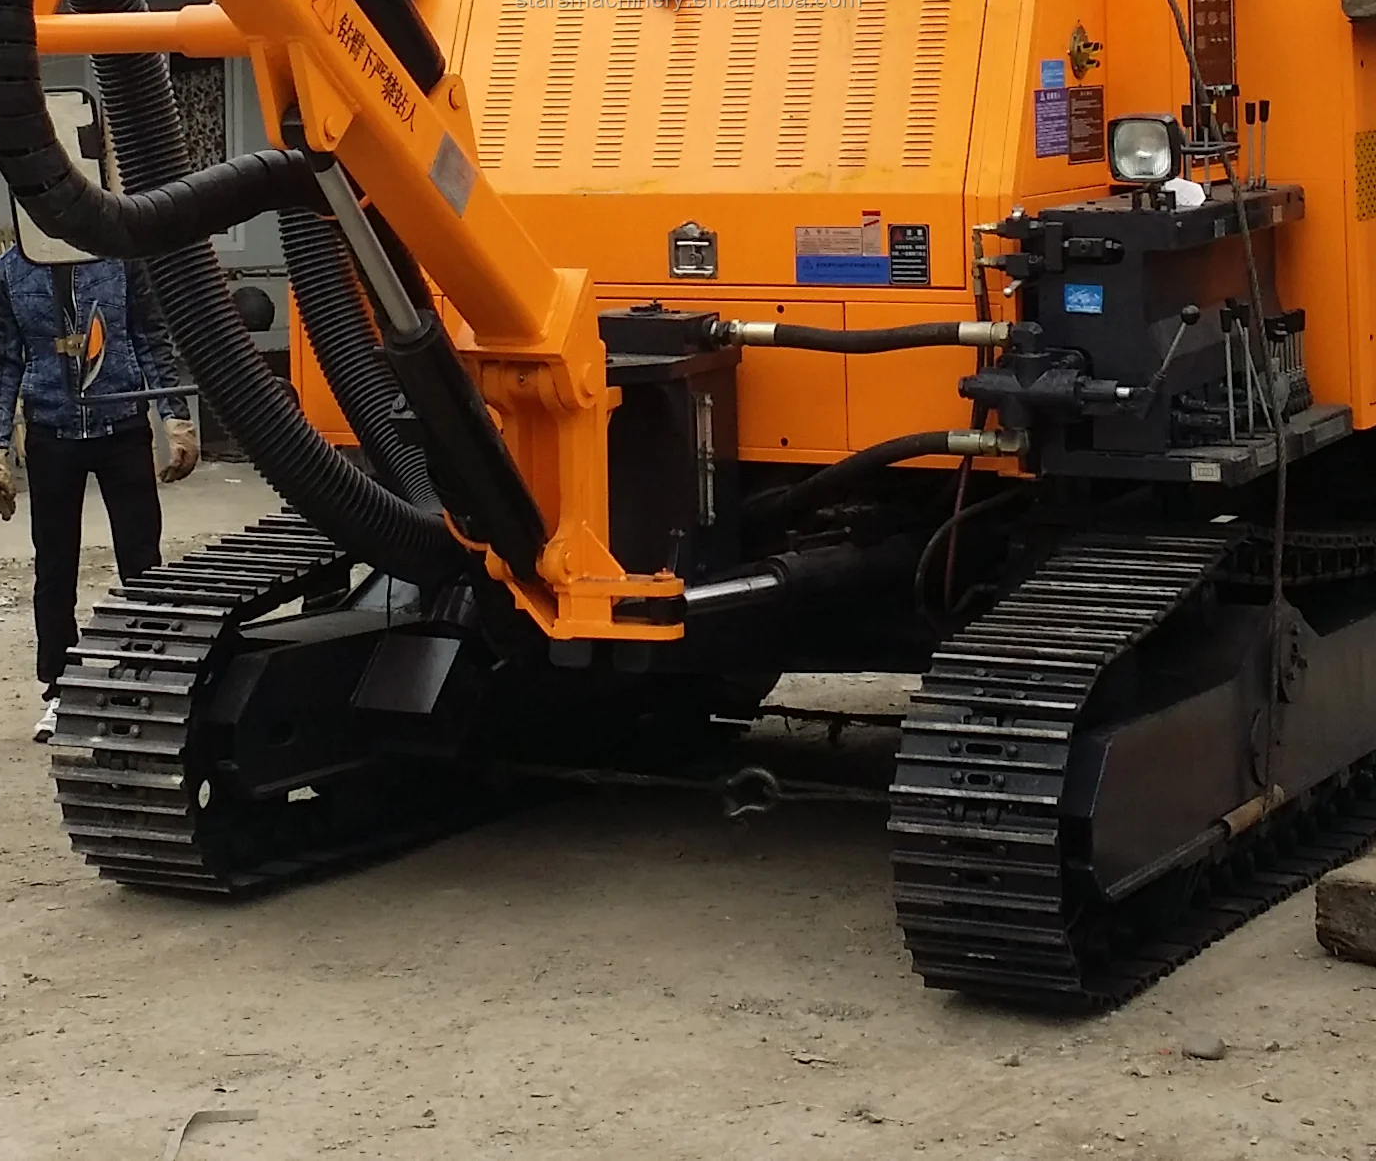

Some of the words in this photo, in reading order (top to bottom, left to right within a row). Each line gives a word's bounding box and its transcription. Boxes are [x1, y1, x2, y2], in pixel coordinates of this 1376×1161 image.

[336, 12, 416, 132] 钻臂下严禁站人
